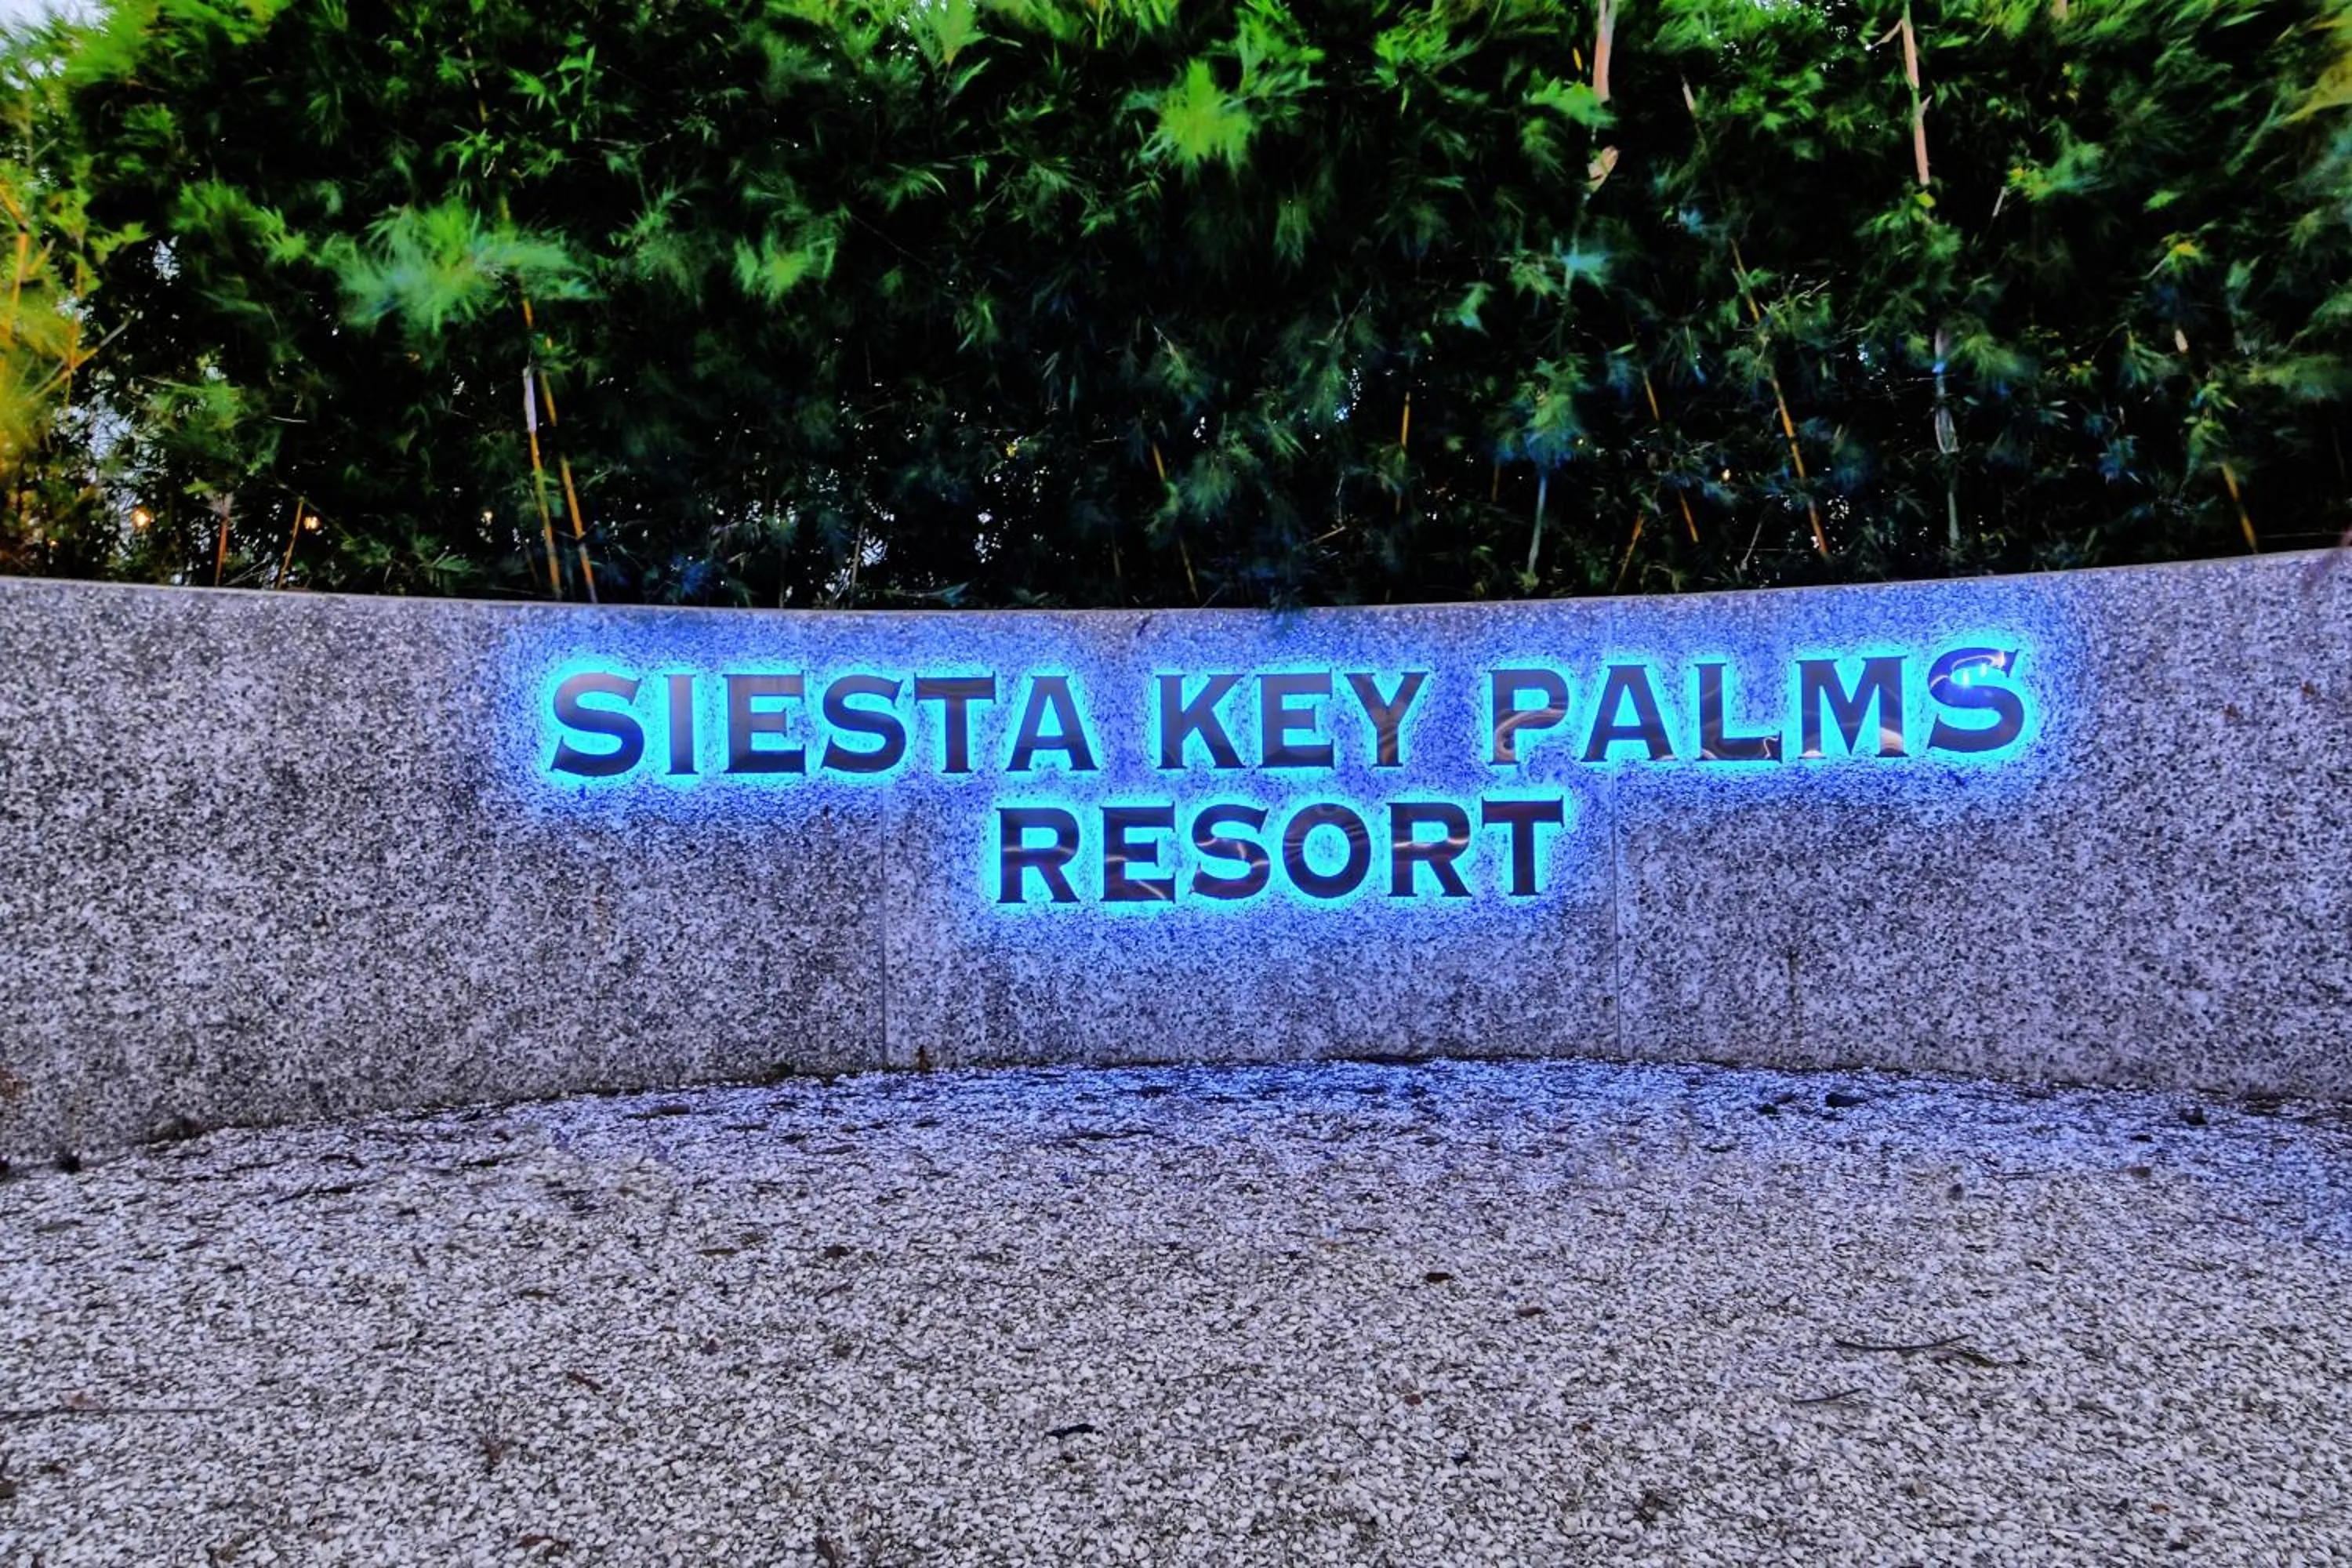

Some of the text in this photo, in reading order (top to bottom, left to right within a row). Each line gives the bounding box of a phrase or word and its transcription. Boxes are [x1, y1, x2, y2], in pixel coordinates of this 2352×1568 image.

[550, 648, 2025, 776] SIESTA KEY PALMS
[996, 795, 1564, 904] RESORT
